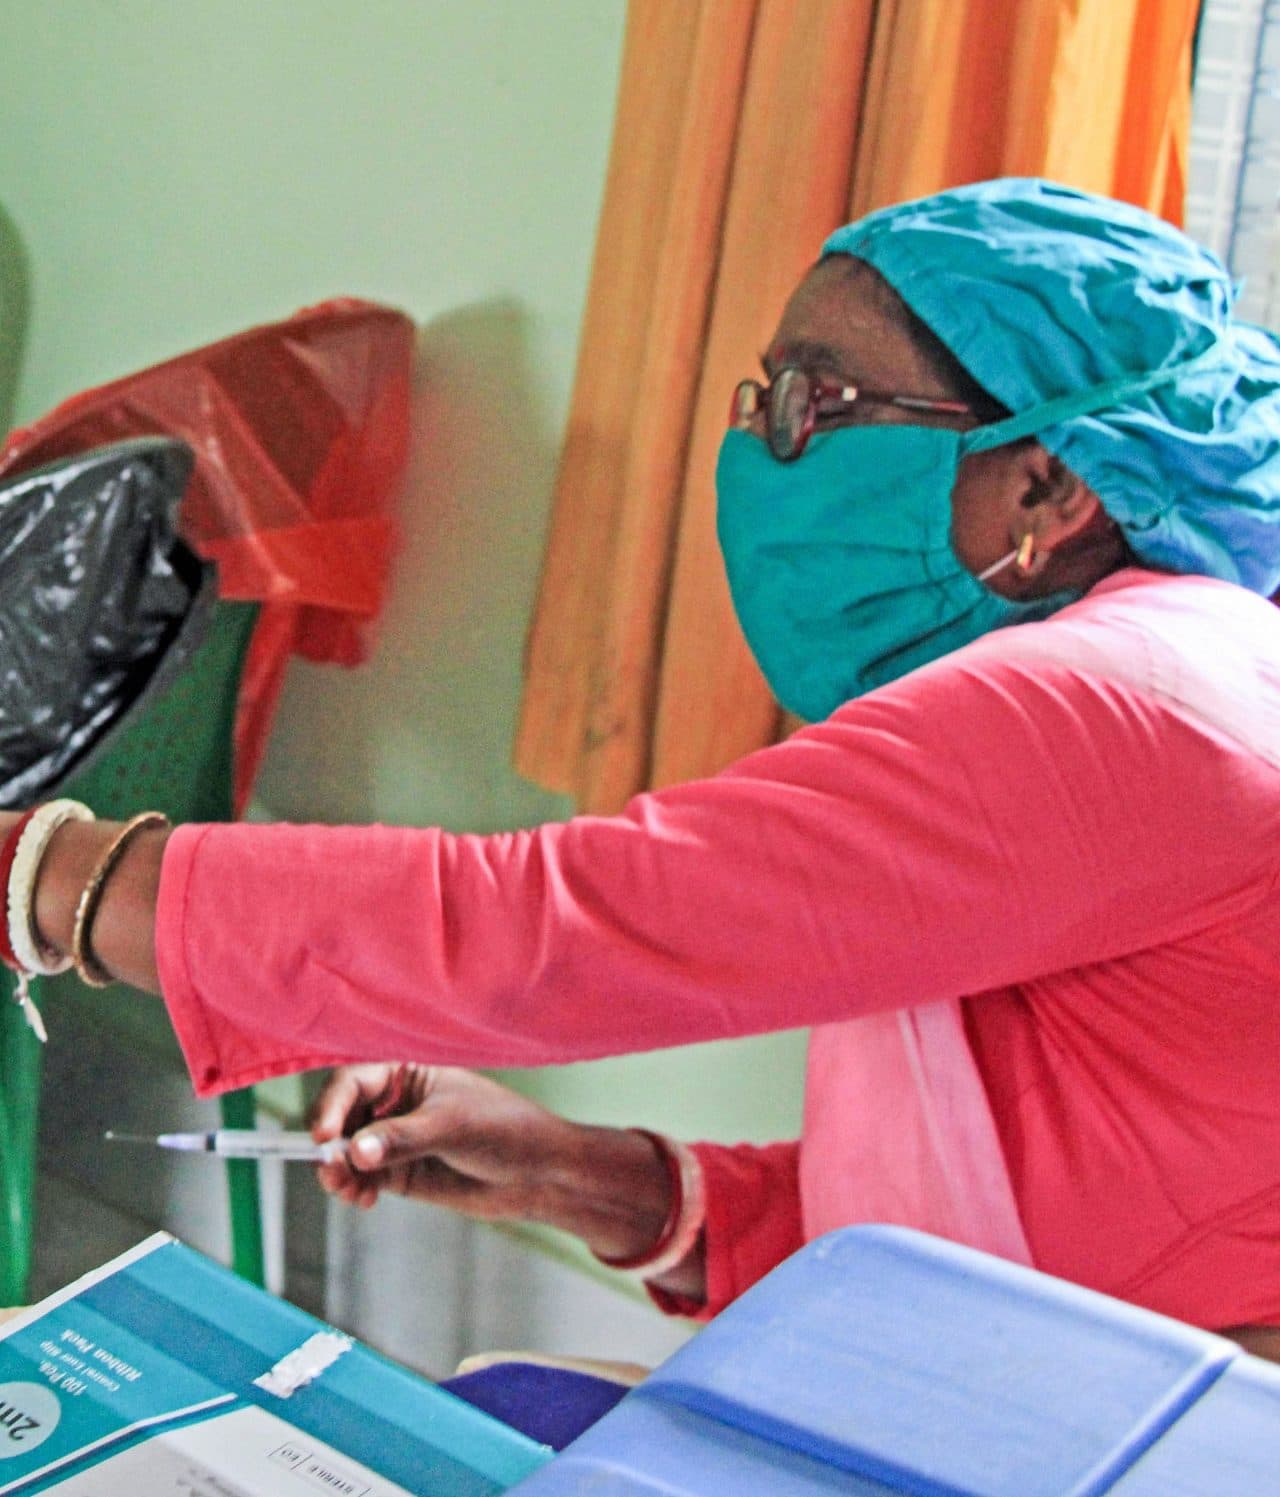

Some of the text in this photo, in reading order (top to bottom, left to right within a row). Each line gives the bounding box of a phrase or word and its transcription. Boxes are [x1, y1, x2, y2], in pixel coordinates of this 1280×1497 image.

[60, 1328, 143, 1383] Ribbon Pack
[60, 1376, 88, 1396] 100
